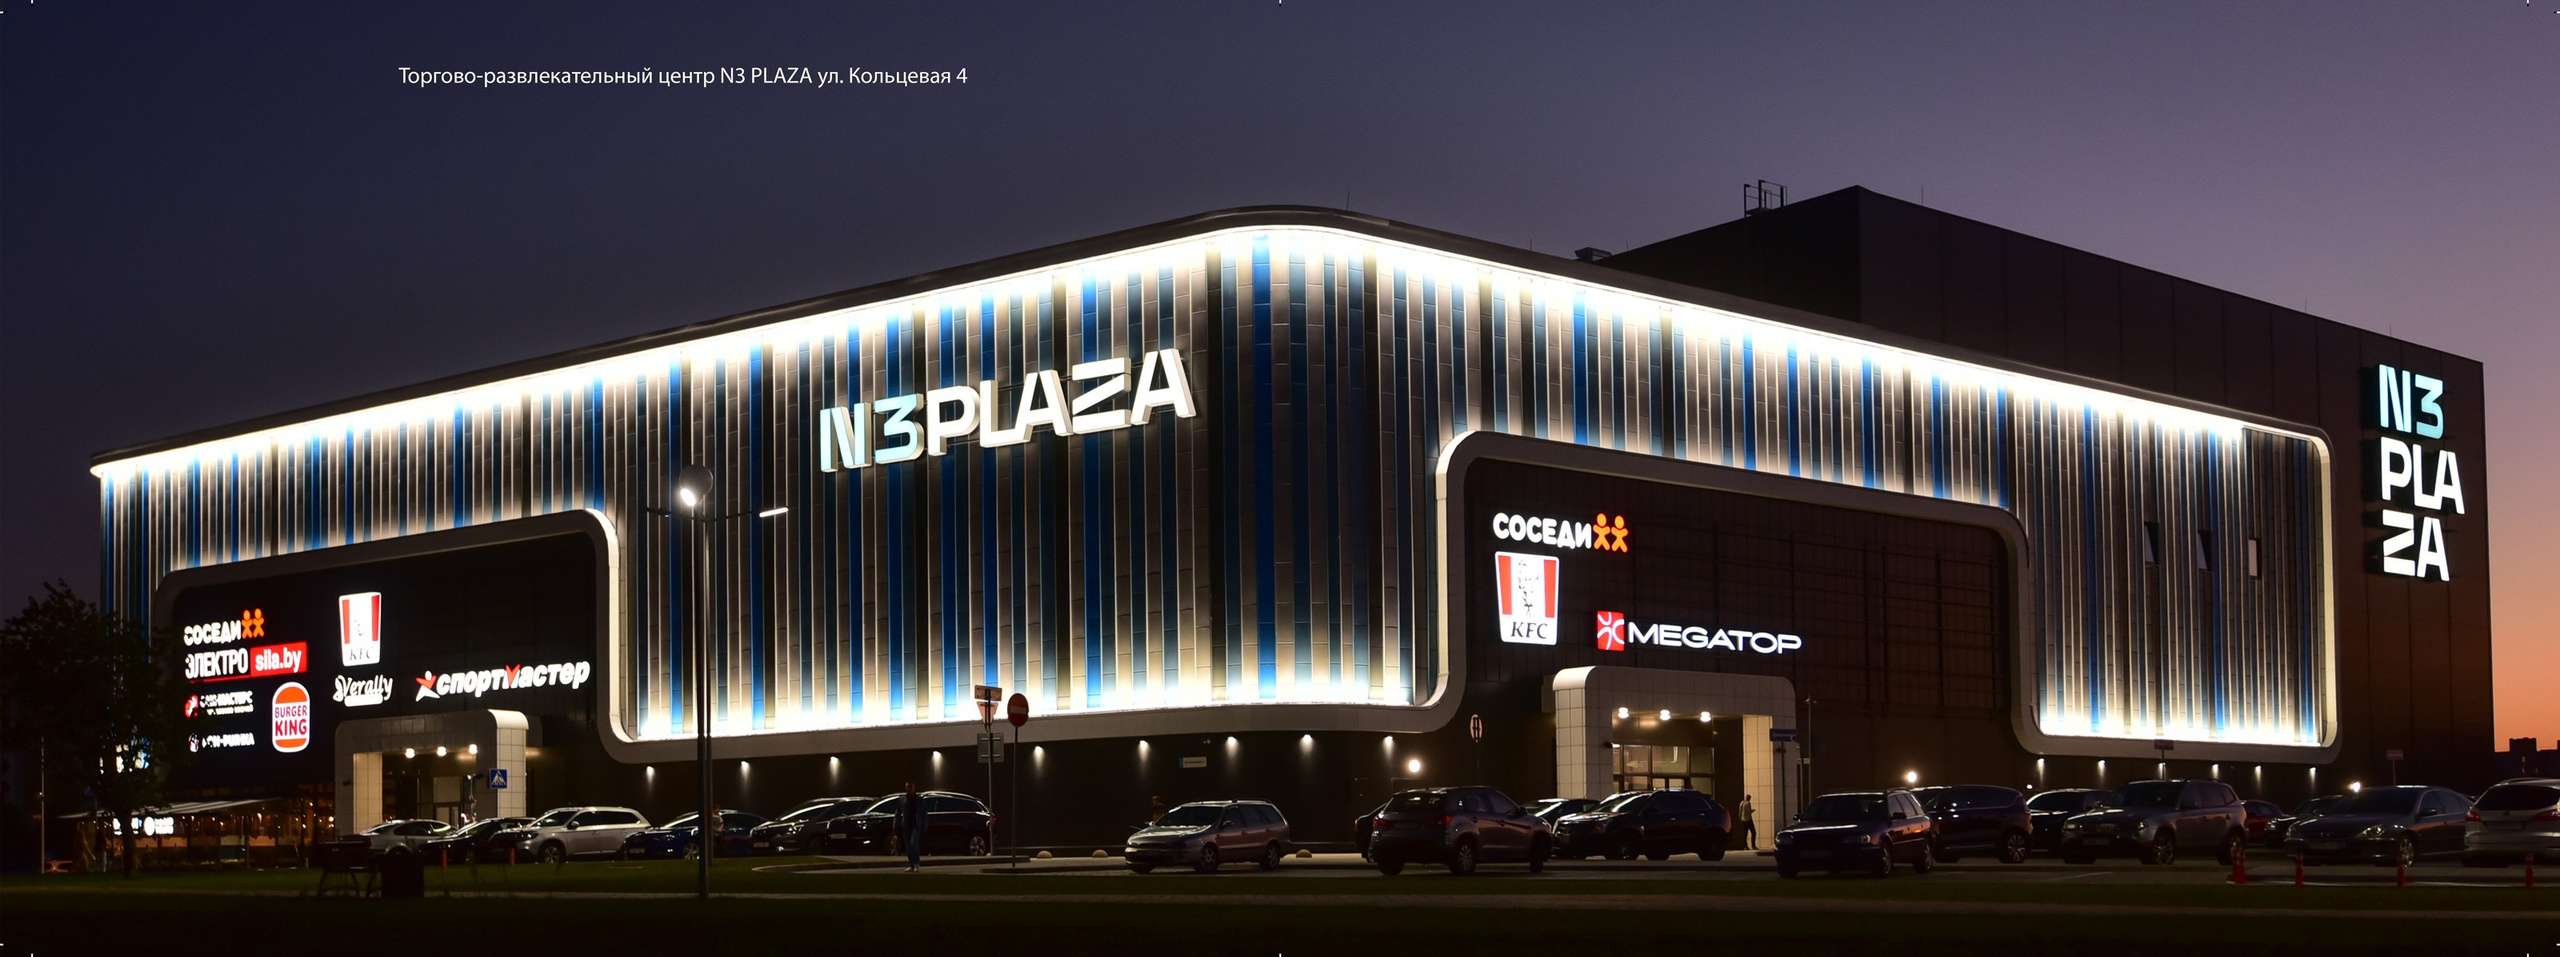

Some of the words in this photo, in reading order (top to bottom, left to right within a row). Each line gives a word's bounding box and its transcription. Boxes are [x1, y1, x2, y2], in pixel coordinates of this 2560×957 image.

[2379, 363, 2444, 440] N3
[2380, 436, 2465, 515] PLA
[1493, 512, 1592, 549] СОСЕДИ
[2382, 509, 2450, 582] ZA
[184, 619, 242, 646] СОСЕДИ
[1511, 621, 1548, 639] KFC
[1628, 621, 1802, 654] MEGATOP
[185, 647, 248, 679] ЭЛЕКТРО
[255, 646, 302, 673] sila.by
[274, 704, 308, 718] BURGER
[275, 718, 308, 737] KING
